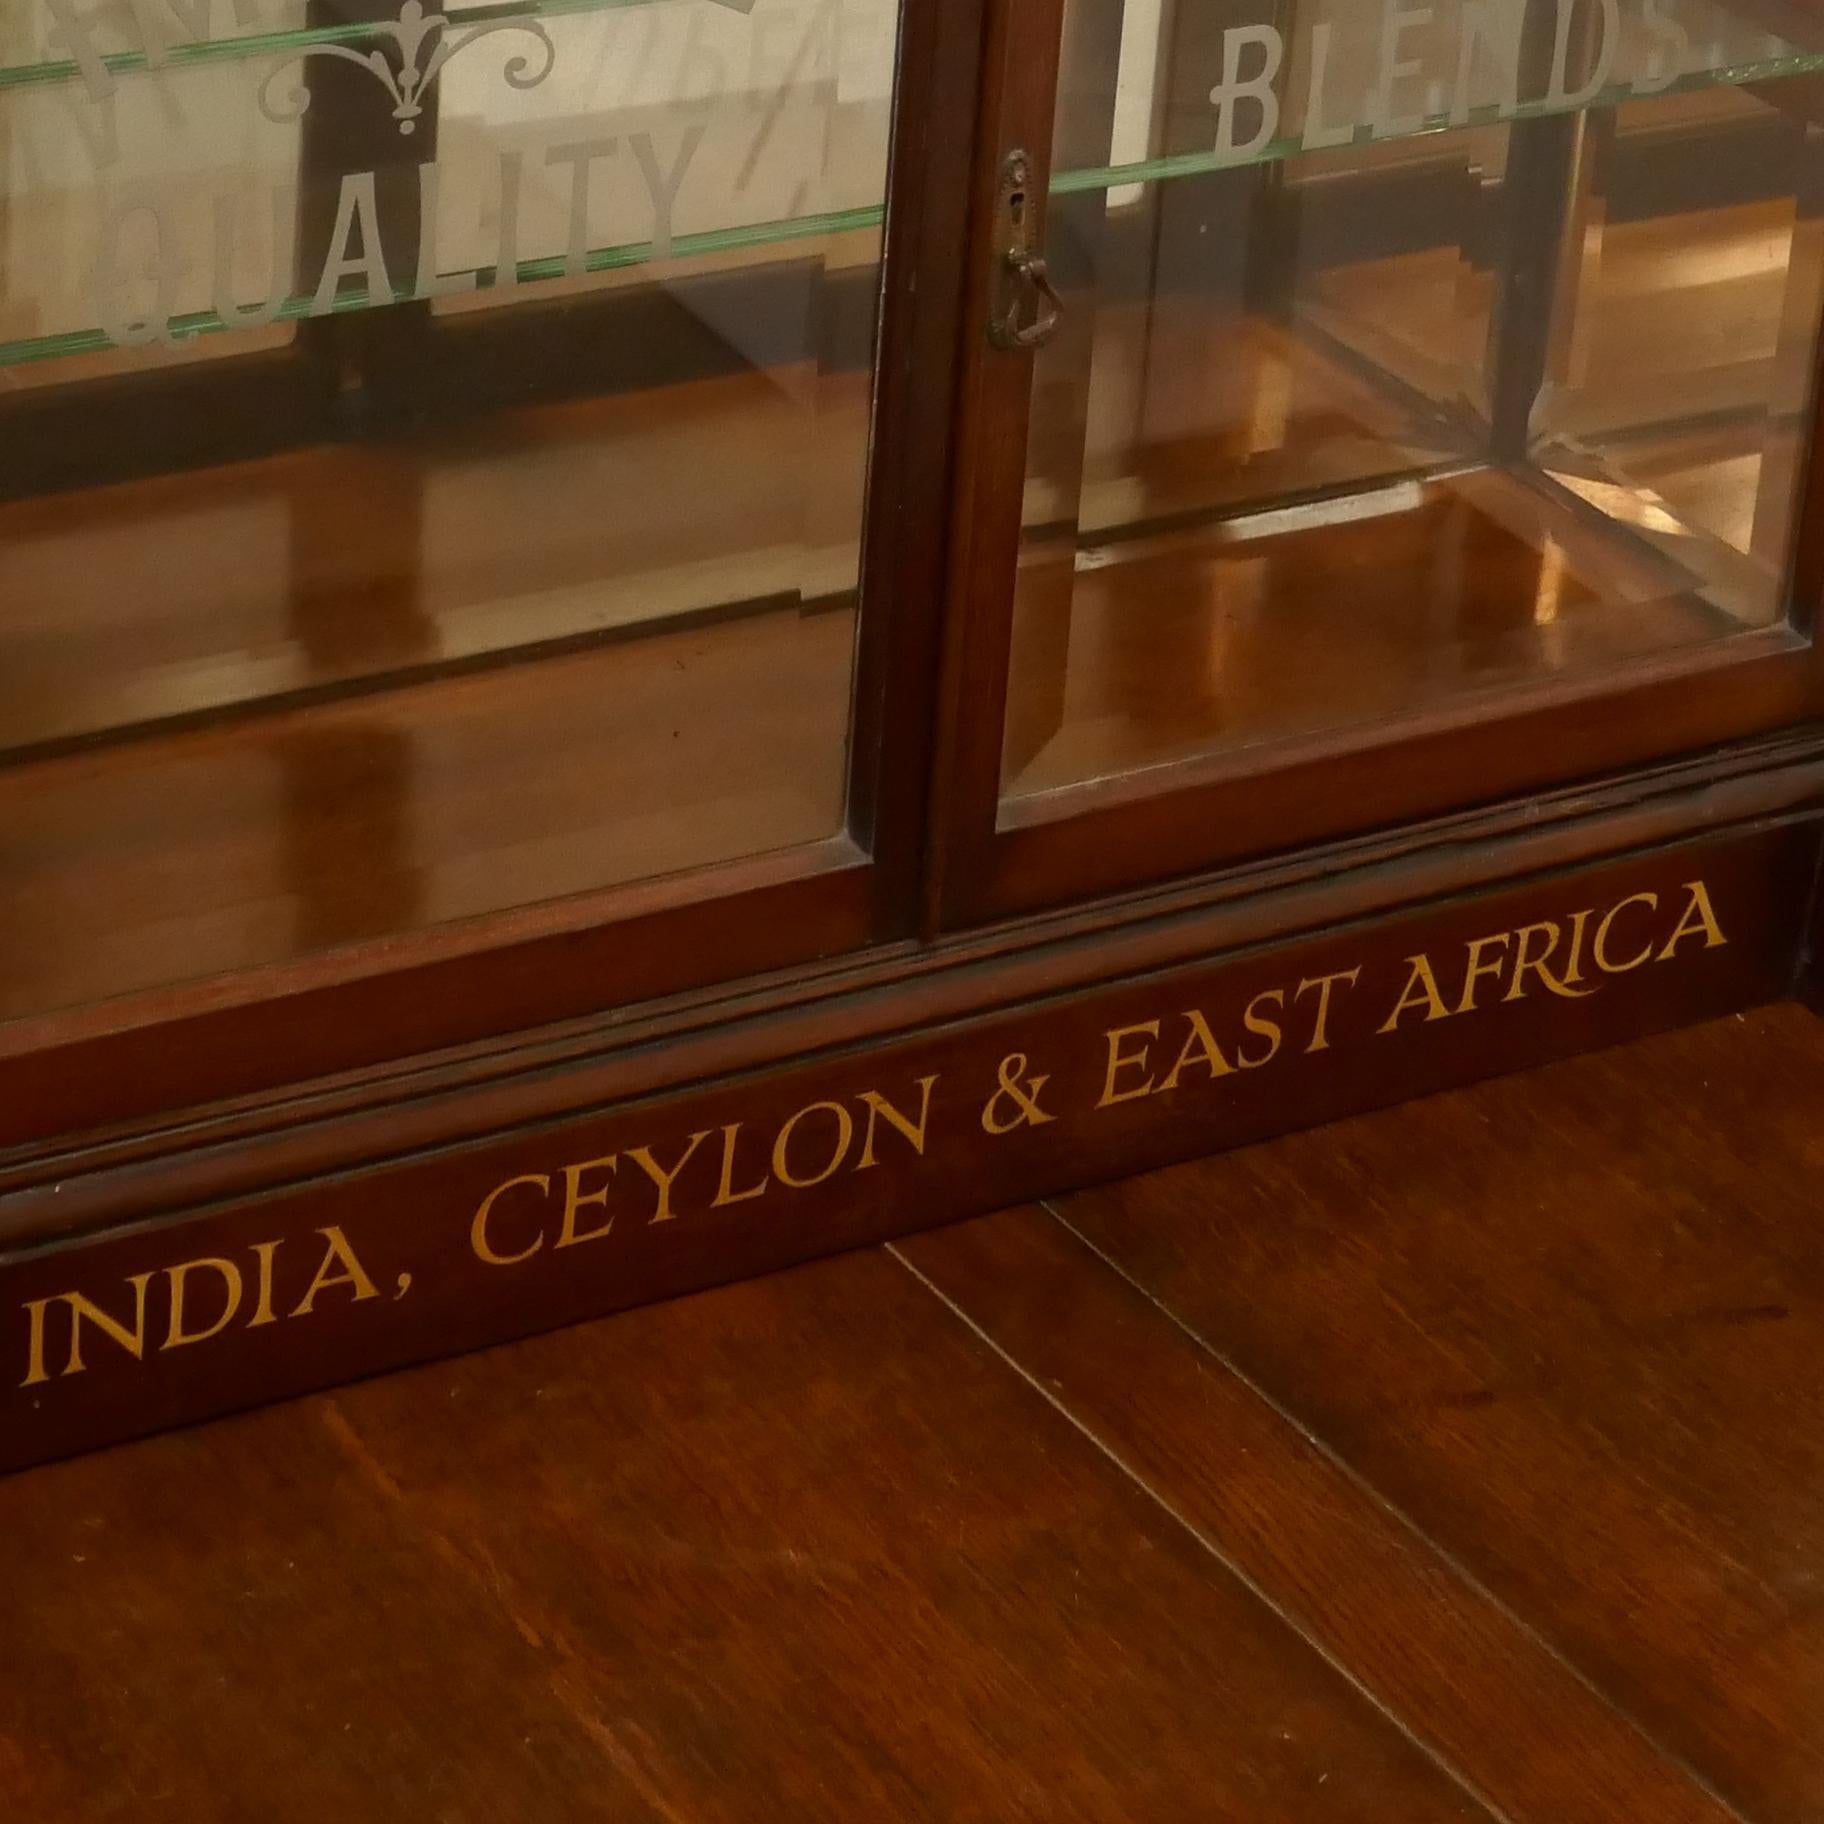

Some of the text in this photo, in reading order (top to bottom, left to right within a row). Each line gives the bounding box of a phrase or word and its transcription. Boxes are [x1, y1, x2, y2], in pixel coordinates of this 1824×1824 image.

[92, 124, 708, 349] QUALITY
[17, 879, 1729, 1388] INDIA, CEYLON & EAST AFRICA
